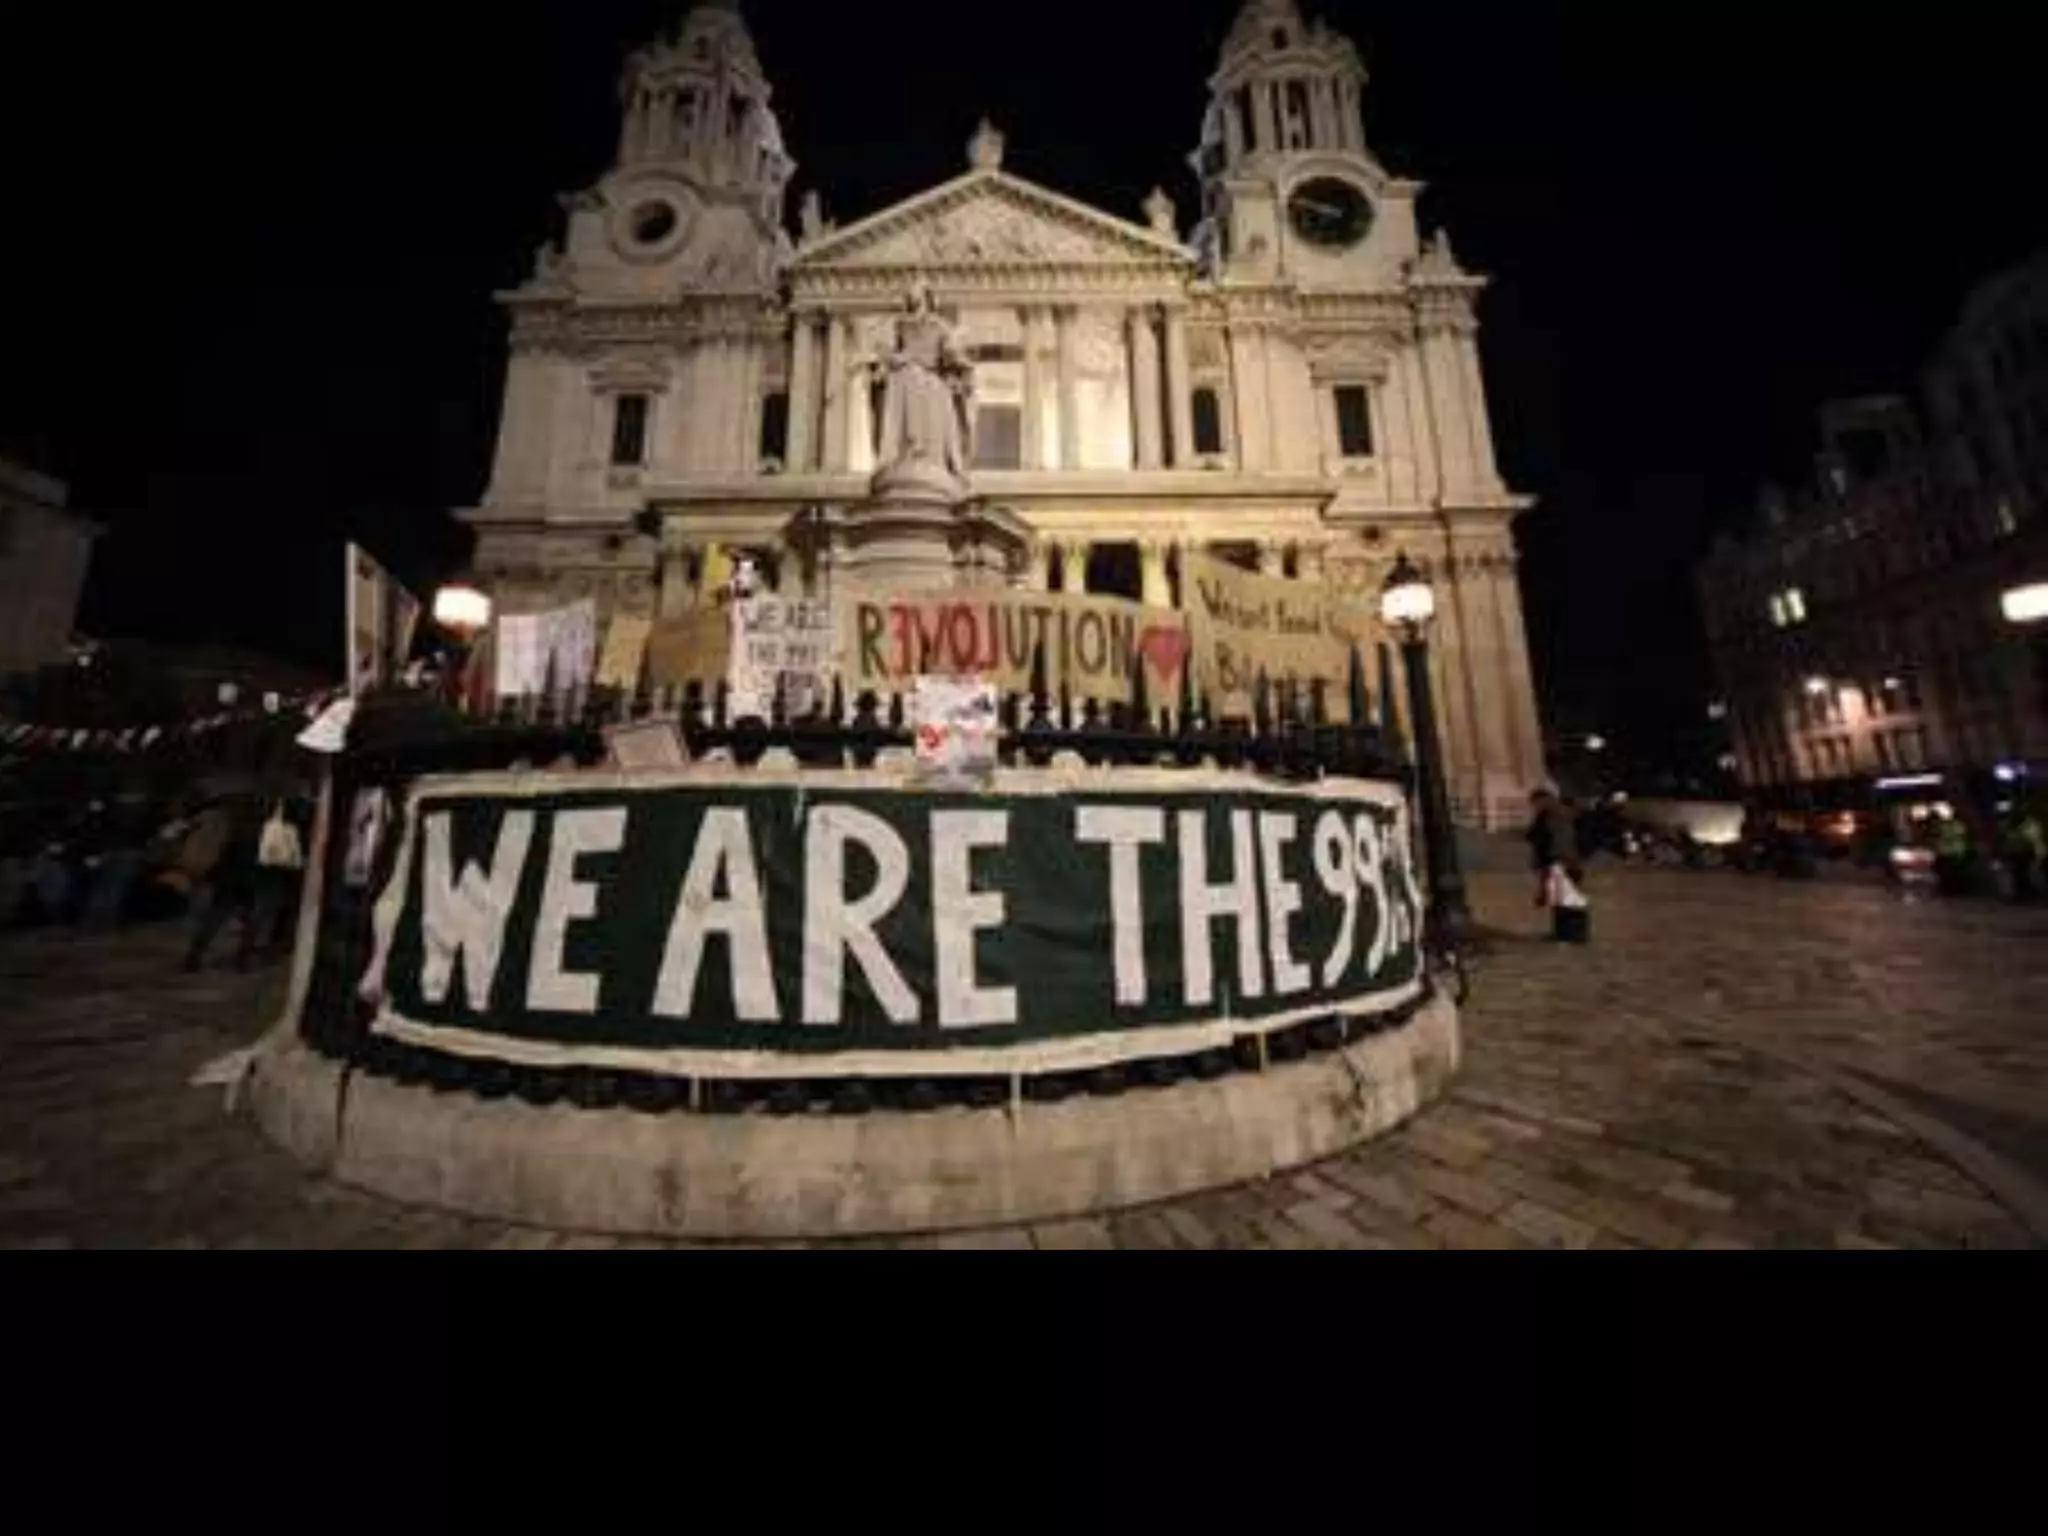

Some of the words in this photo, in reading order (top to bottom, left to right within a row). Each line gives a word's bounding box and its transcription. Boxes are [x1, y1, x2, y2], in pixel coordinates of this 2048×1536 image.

[857, 600, 1137, 679] REVOLUTION
[421, 808, 628, 1013] WE
[652, 804, 1018, 1029] ARE
[1074, 805, 1311, 1006] THE
